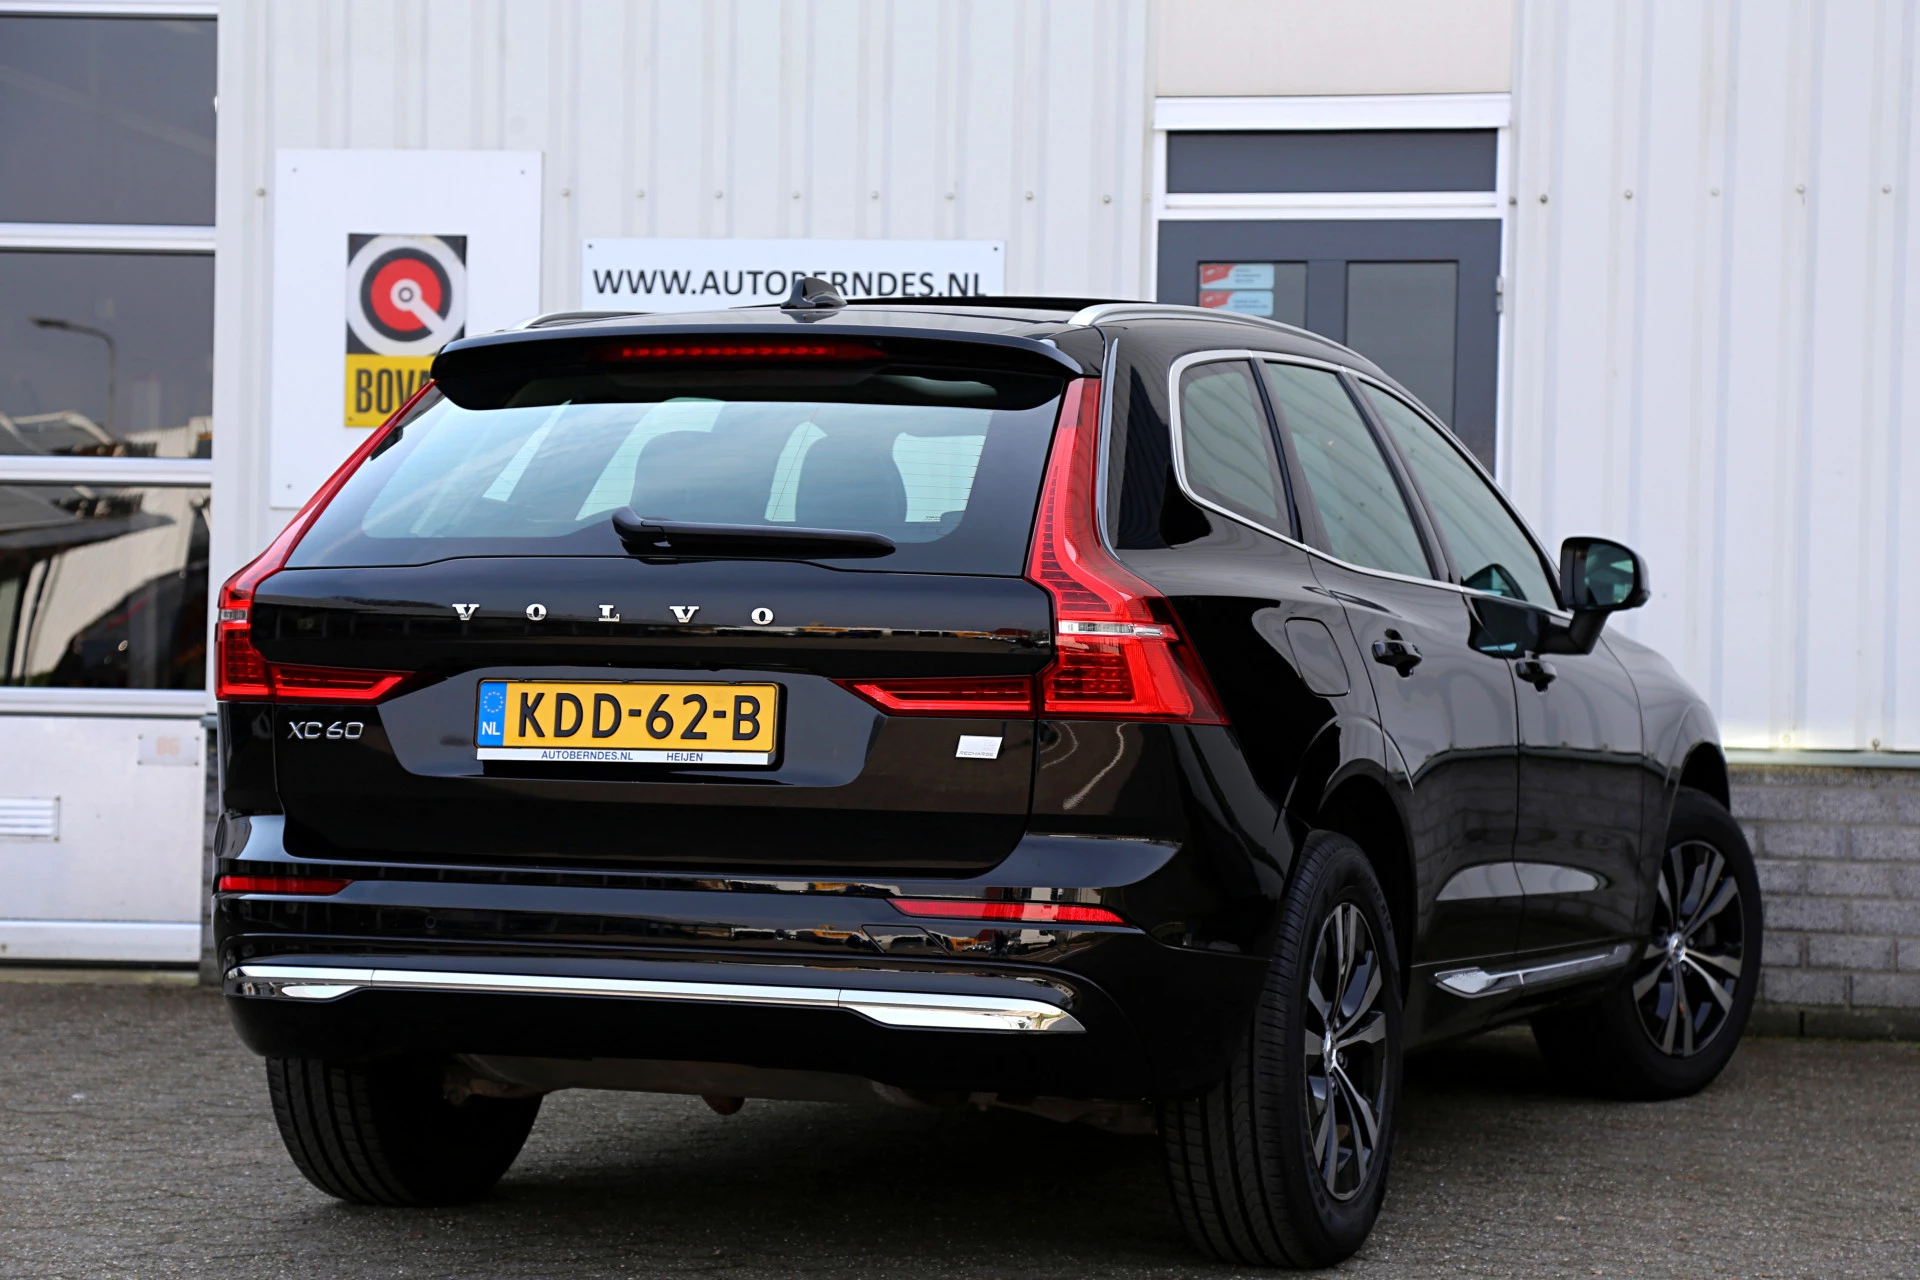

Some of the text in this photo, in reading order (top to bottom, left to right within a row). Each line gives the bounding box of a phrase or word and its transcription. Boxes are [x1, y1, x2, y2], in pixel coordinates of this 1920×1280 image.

[592, 268, 987, 297] WWW.AUTORNDES.NL
[355, 368, 430, 414] BOV
[452, 603, 774, 625] VOLVO
[481, 721, 501, 736] NL
[518, 692, 761, 741] KDD-62-B
[541, 750, 704, 762] AUTOBERNDES.NL HEIJEN
